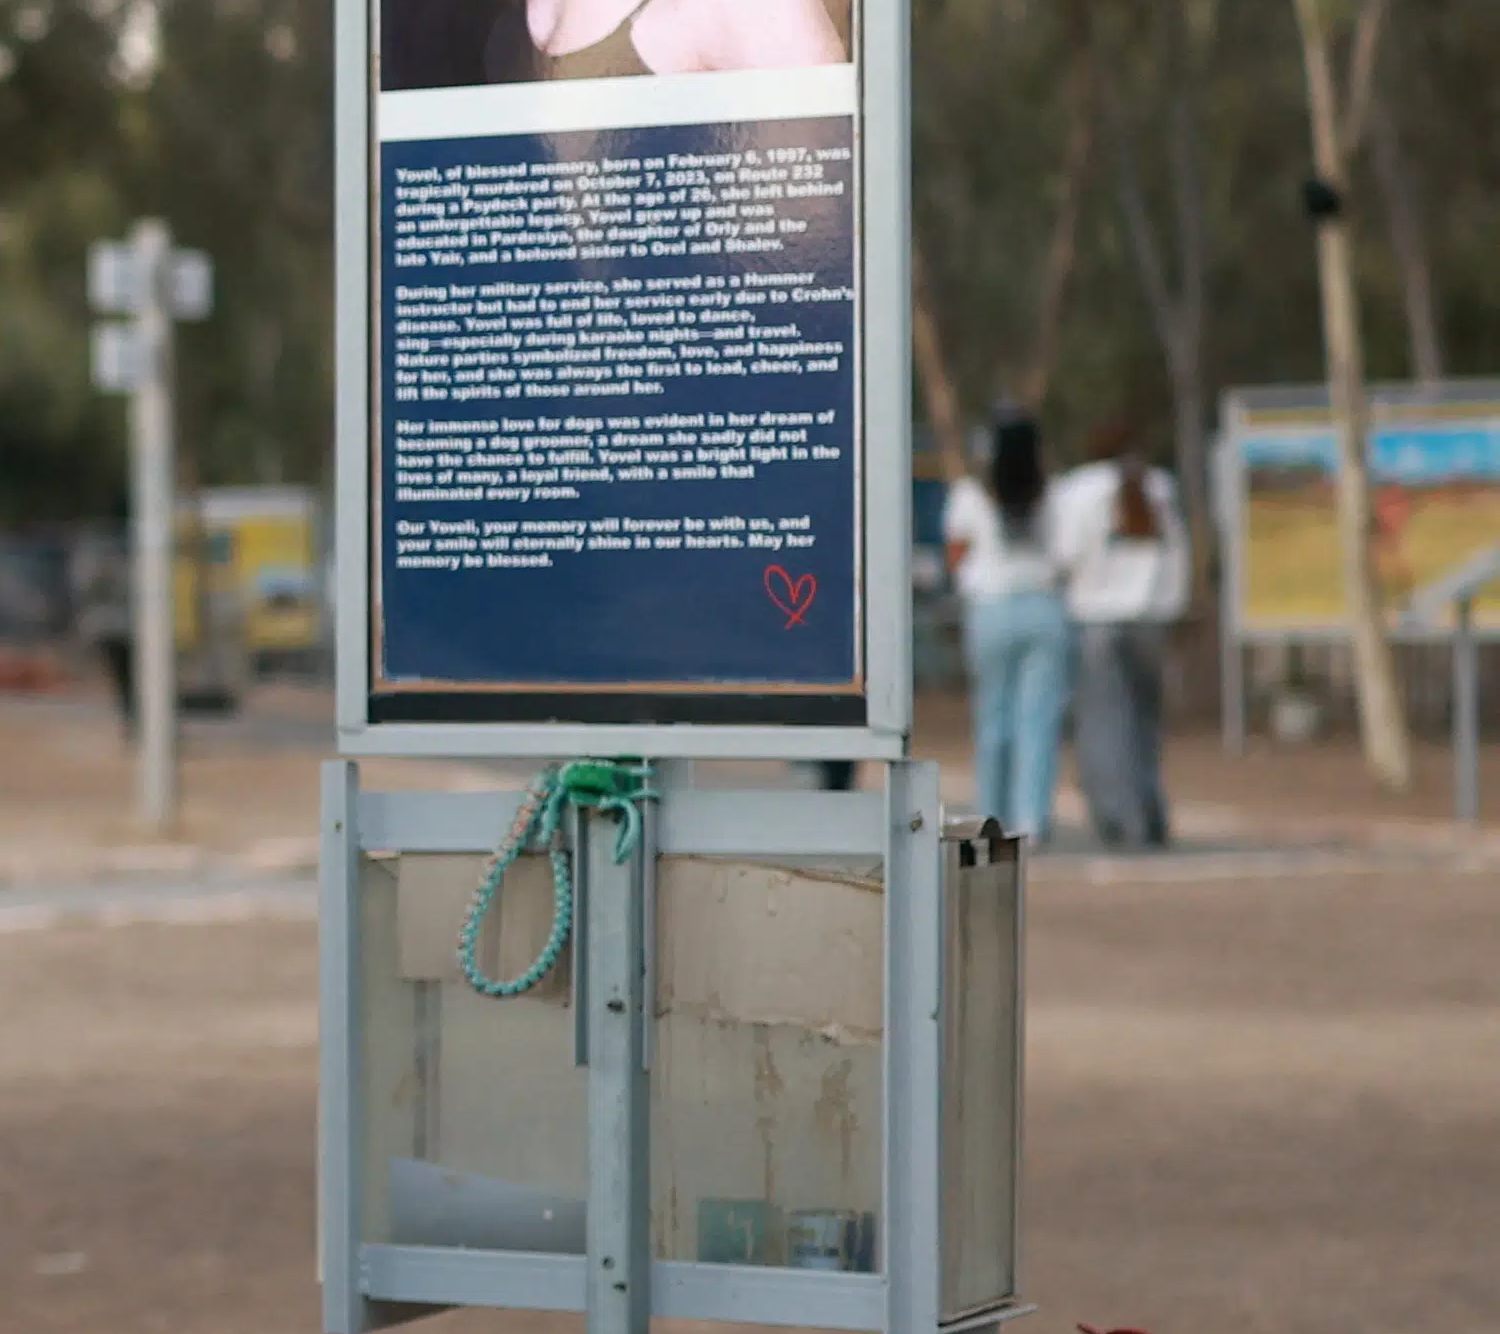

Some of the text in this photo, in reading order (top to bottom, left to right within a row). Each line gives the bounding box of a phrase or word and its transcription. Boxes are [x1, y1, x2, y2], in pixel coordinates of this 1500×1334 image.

[446, 166, 461, 179] of
[466, 163, 526, 178] blessed
[530, 162, 598, 178] memory,
[602, 157, 641, 172] born
[644, 159, 664, 169] on
[668, 152, 740, 171] February
[767, 149, 812, 165] 1997,
[816, 149, 850, 161] was
[395, 167, 824, 201] tragically murdered on October 7, 2023, on Route 232
[395, 201, 445, 218] during
[448, 203, 459, 213] a
[531, 195, 577, 212] party.
[581, 194, 600, 207] At
[603, 193, 631, 206] the
[634, 194, 665, 208] age
[668, 190, 686, 203] of
[720, 187, 750, 201] she
[753, 186, 783, 200] left
[786, 183, 844, 198] behind
[395, 222, 416, 233] an
[418, 214, 524, 234] unforgettable
[527, 212, 583, 229] legacy.
[634, 210, 677, 224] grew
[679, 209, 702, 222] up
[704, 204, 736, 218] and
[740, 205, 774, 217] was
[394, 234, 469, 250] educated
[470, 233, 487, 246] in
[575, 228, 604, 242] the
[605, 225, 680, 243] daughter
[682, 224, 701, 237] of
[704, 223, 740, 239] Orly
[743, 221, 775, 235] and
[777, 220, 807, 233] the
[396, 253, 425, 266] late
[431, 251, 463, 267] Yair,
[469, 250, 497, 263] and
[502, 252, 511, 262] a
[515, 247, 576, 262] beloved
[580, 245, 625, 259] sister
[630, 244, 647, 257] to
[651, 243, 686, 256] Orel
[690, 241, 720, 255] and
[397, 521, 424, 535] Our
[483, 522, 517, 536] your
[521, 521, 586, 536] memory
[590, 519, 619, 532] will
[622, 518, 679, 532] forever
[684, 517, 704, 531] be
[709, 517, 745, 531] with
[749, 519, 774, 532] us,
[779, 516, 810, 530] and
[397, 533, 814, 554] your smile will eternally shine in our hearts. May her
[395, 553, 552, 571] memory be blessed.
